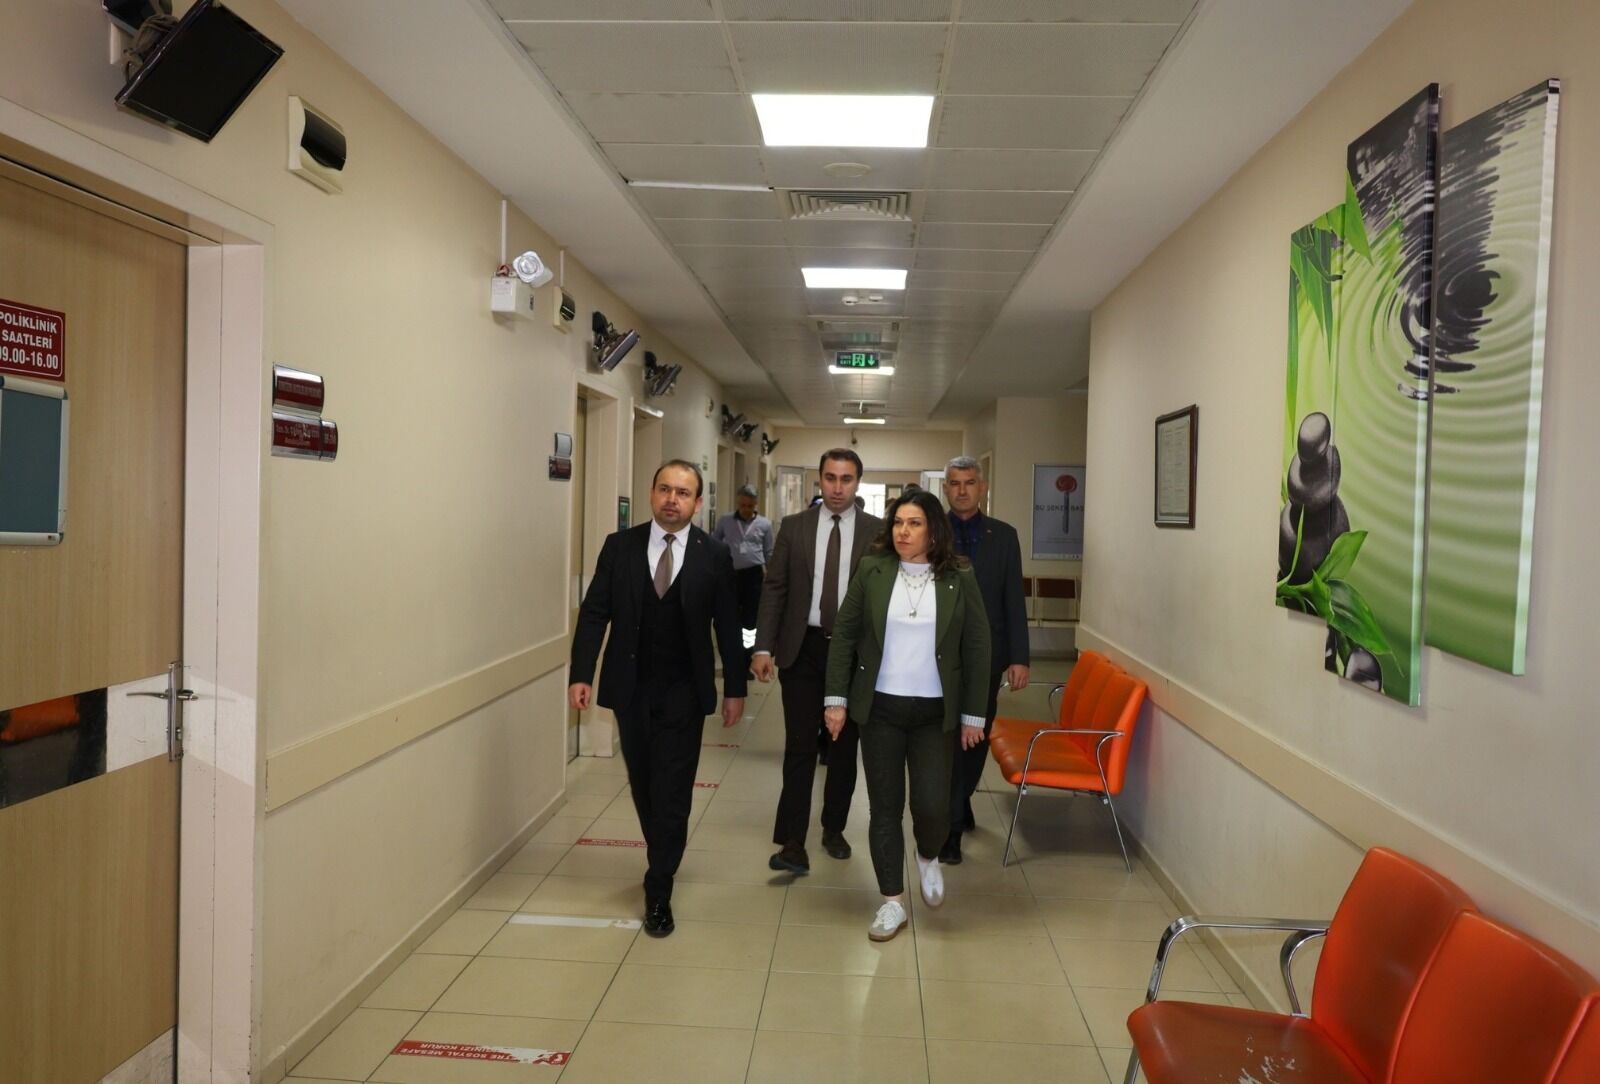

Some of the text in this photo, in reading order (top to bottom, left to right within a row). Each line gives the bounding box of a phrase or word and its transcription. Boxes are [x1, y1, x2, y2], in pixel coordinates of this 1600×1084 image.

[2, 329, 53, 349] SAATLERİ
[0, 346, 59, 370] 9.00-16.00
[447, 1051, 488, 1059] SOSYAL
